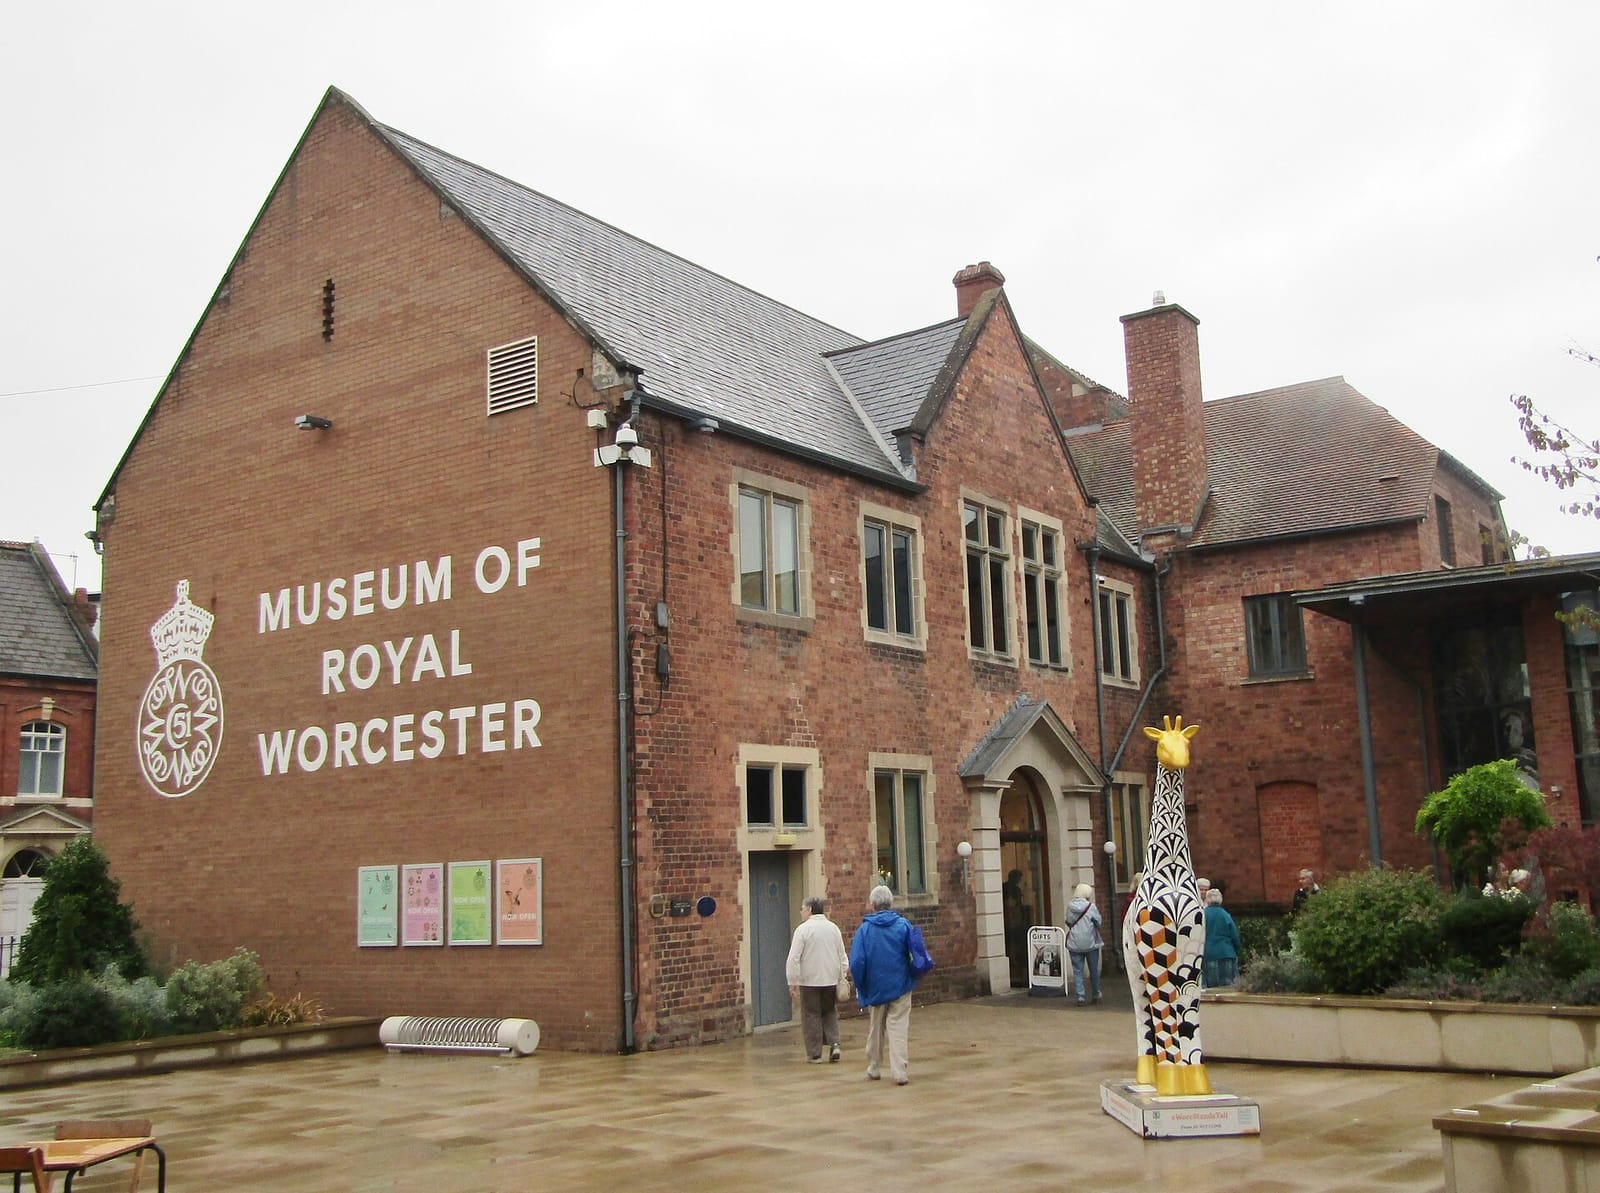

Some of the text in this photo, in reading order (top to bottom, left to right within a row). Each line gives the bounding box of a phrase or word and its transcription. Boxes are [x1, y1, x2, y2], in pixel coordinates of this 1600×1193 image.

[258, 537, 542, 634] MUSEUM OF
[321, 629, 473, 695] ROYAL
[257, 698, 542, 776] WORCESTER
